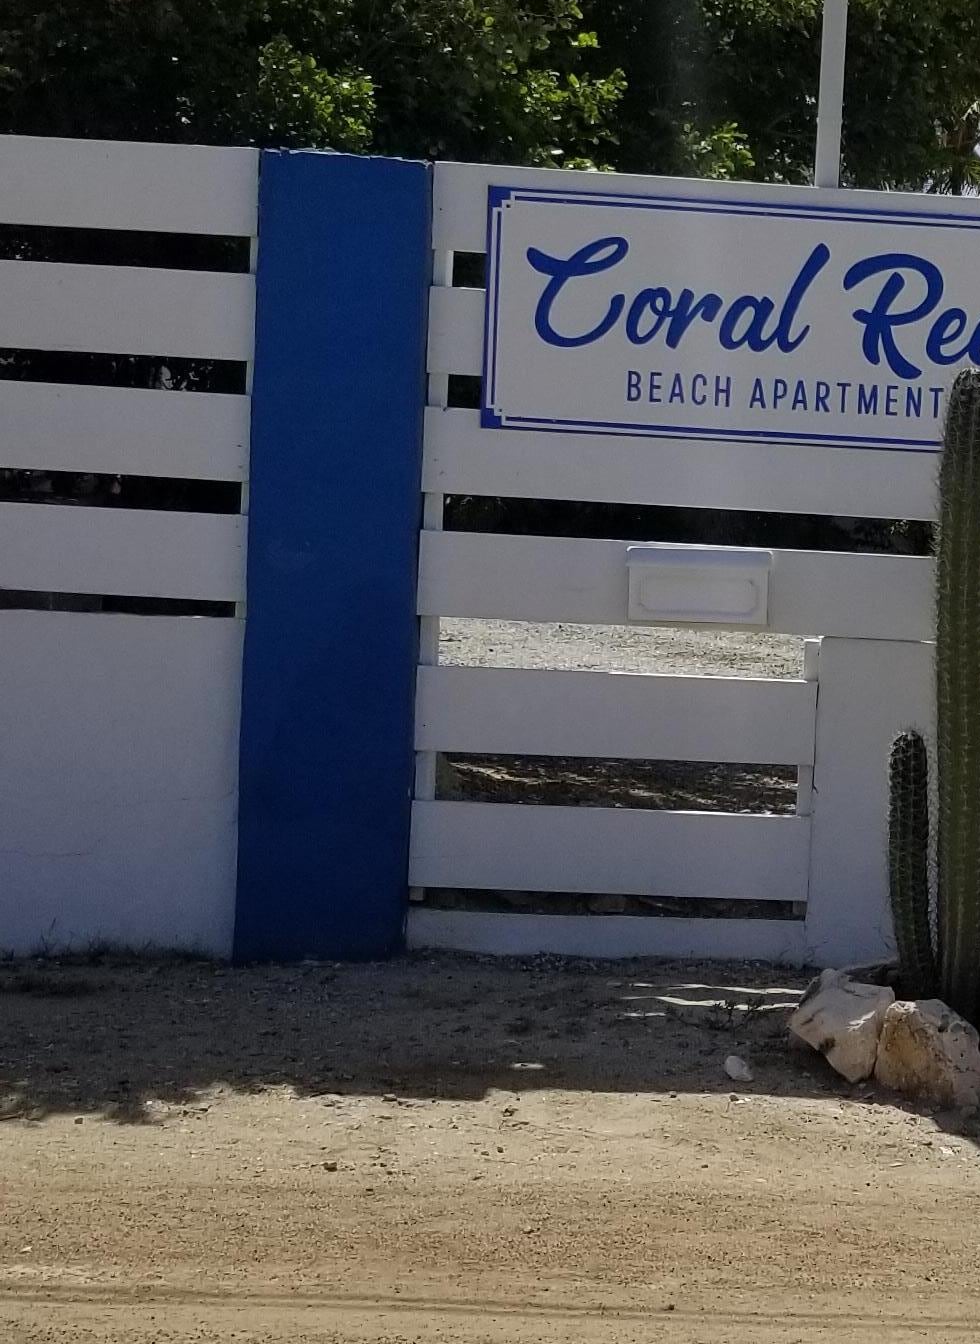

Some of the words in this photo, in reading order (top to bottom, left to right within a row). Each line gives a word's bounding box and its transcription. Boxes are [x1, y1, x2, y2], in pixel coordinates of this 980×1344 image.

[527, 236, 830, 353] Coral
[626, 370, 731, 408] BEACH
[749, 377, 947, 419] APARTMENT
